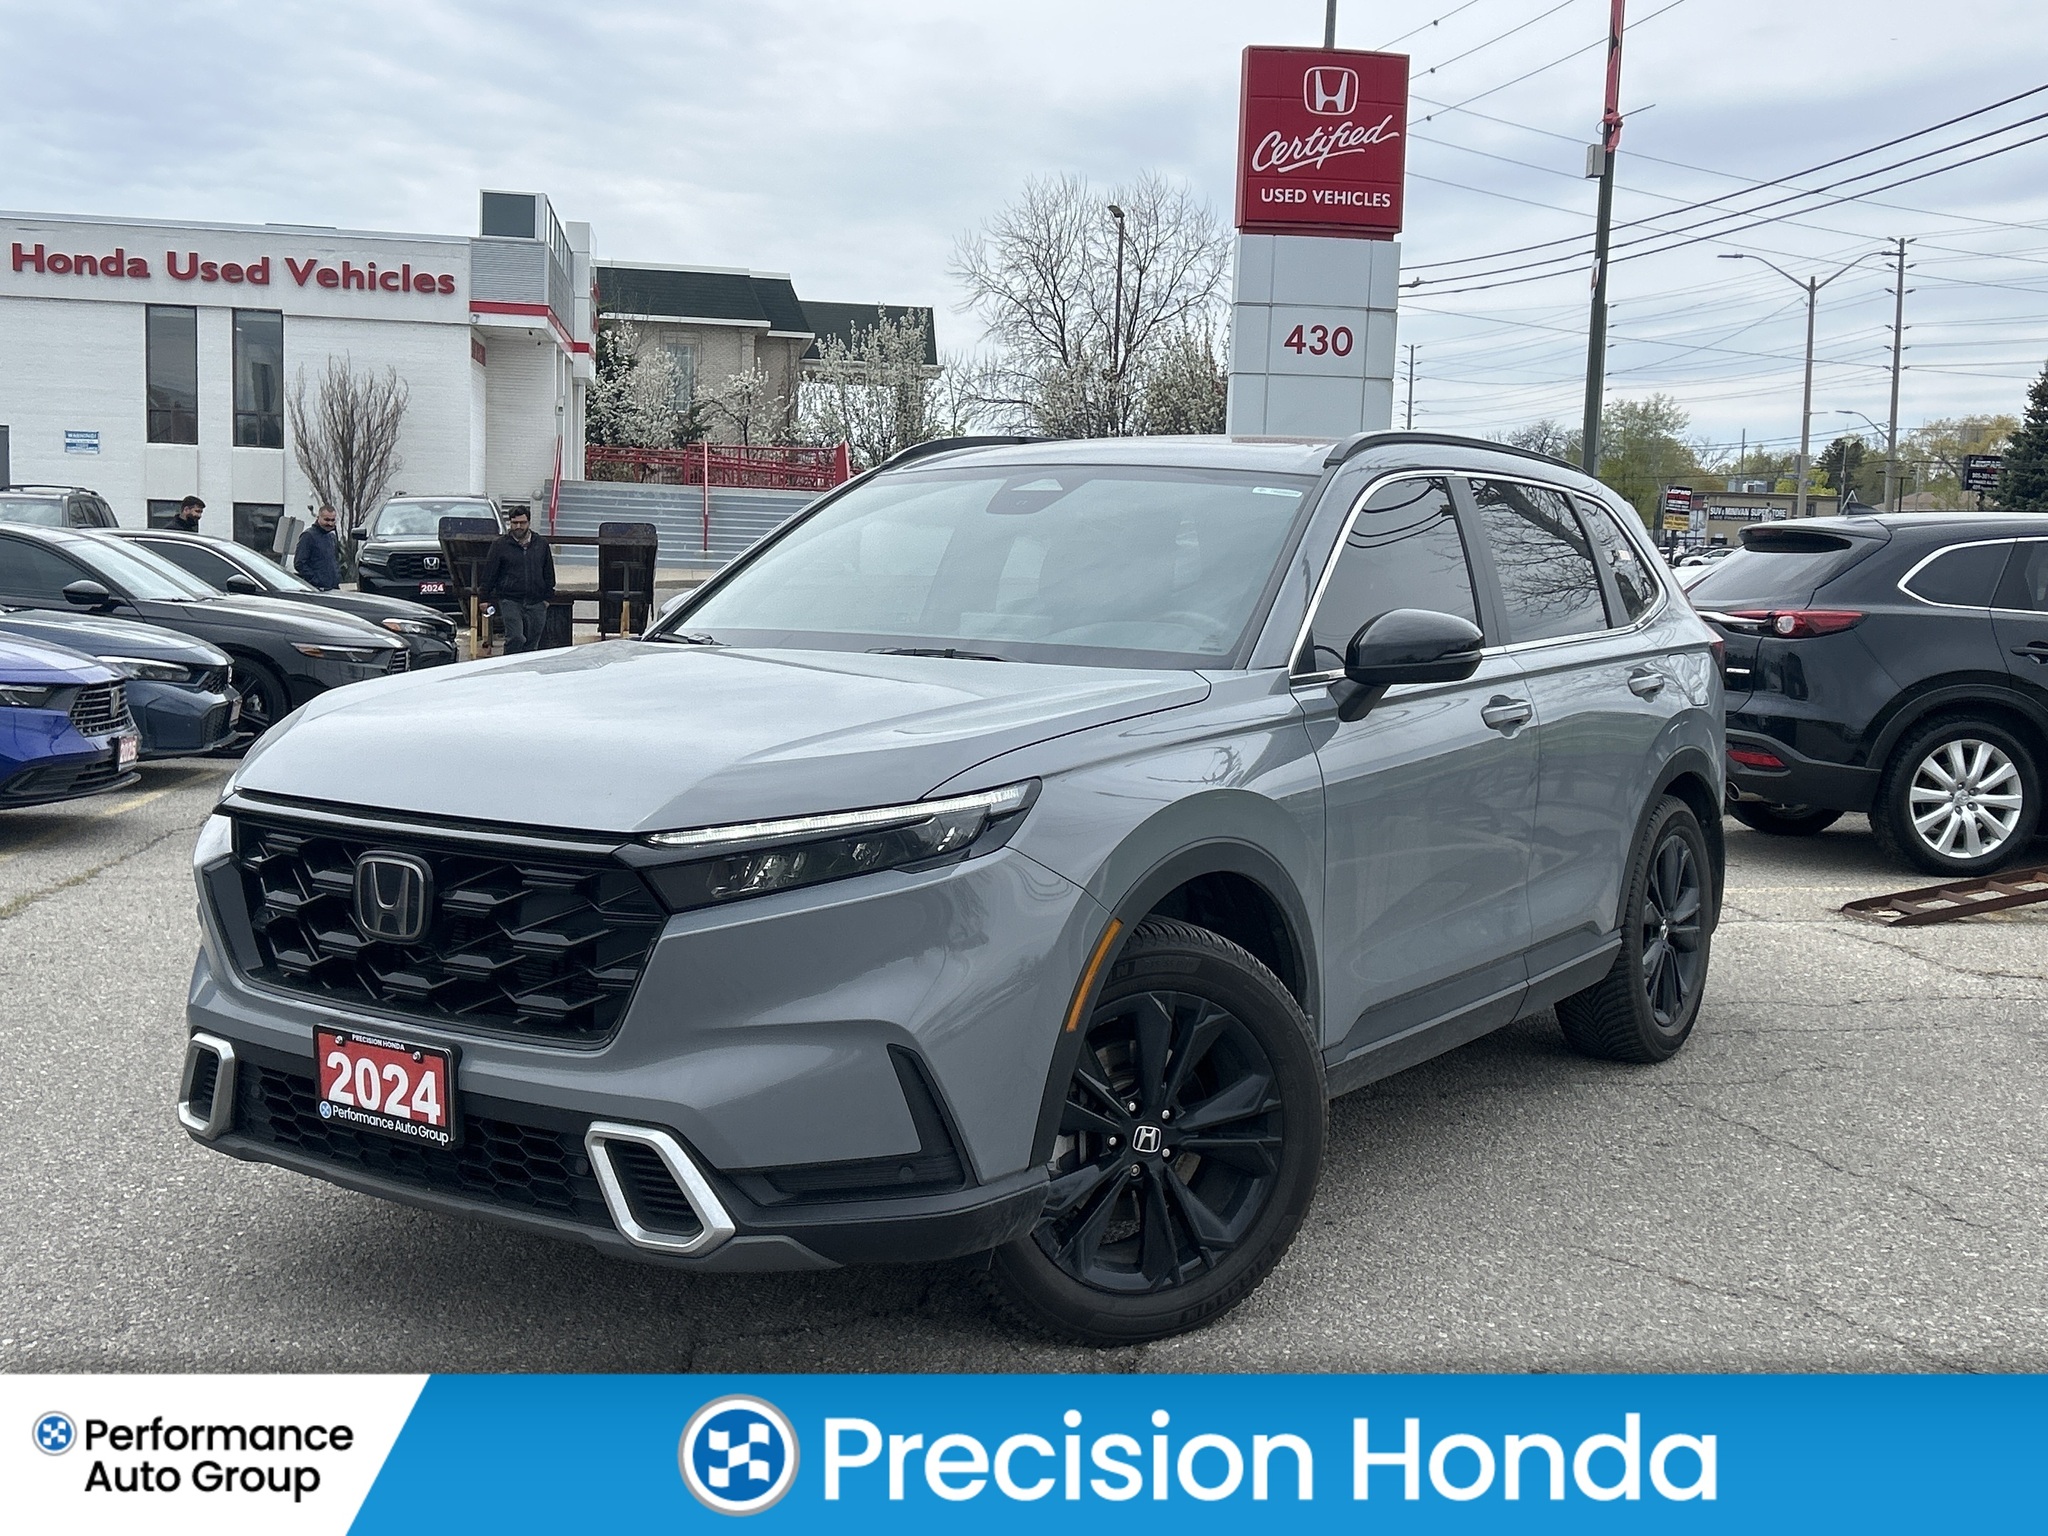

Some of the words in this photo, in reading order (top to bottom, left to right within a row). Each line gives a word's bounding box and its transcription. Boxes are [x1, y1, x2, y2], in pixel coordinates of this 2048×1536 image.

[1251, 114, 1400, 173] Certified
[1261, 187, 1308, 204] USED
[1312, 189, 1392, 208] VEHICLES
[11, 242, 150, 279] Honda
[166, 250, 270, 285] Used
[284, 256, 456, 295] Vehicles
[1284, 323, 1354, 358] 430
[1710, 507, 1722, 515] SUV
[1725, 507, 1750, 516] MINIVAN
[421, 584, 444, 592] 2024
[352, 1033, 383, 1047] PRECISION
[382, 1040, 406, 1051] HONDA
[326, 1051, 441, 1125] 2024
[332, 1104, 394, 1131] Performance
[395, 1120, 418, 1135] Auto
[418, 1125, 449, 1147] Group
